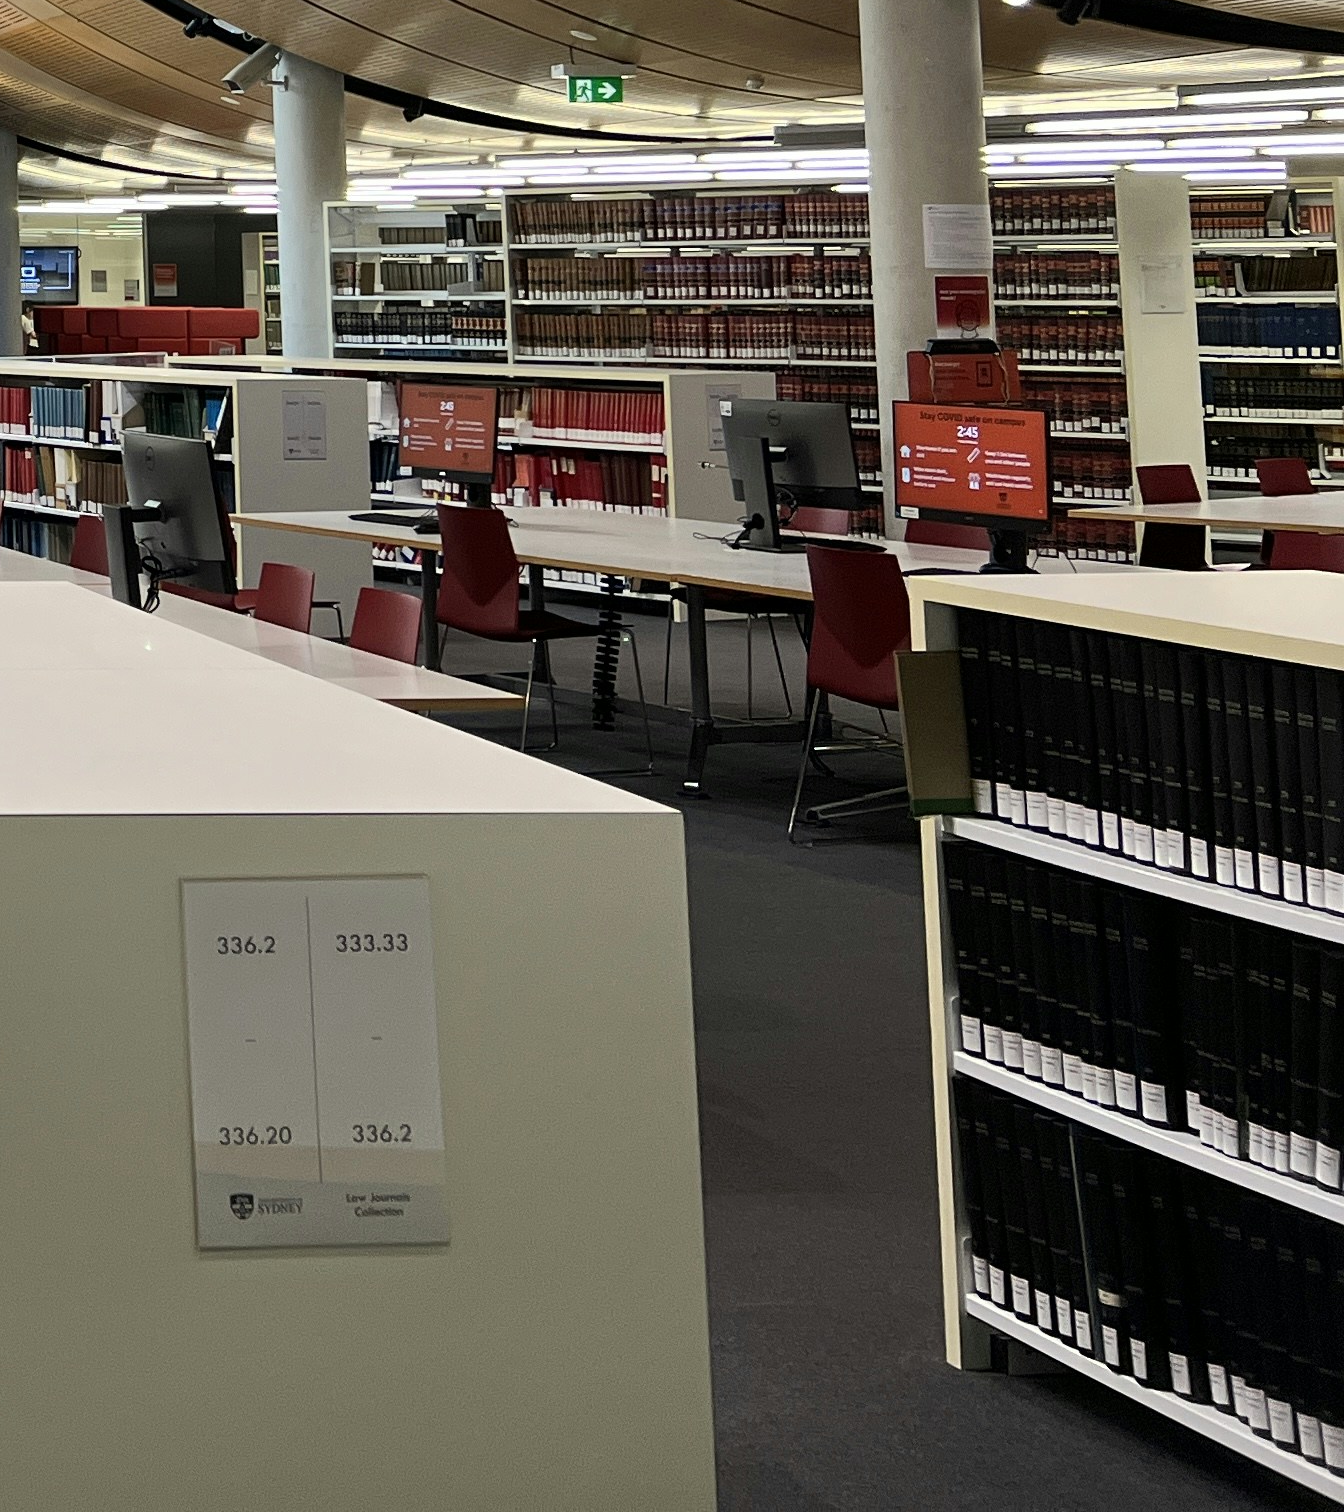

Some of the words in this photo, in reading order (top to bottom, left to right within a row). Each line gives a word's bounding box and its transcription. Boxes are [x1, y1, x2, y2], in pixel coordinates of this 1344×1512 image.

[936, 412, 963, 422] COVID
[956, 425, 979, 438] 2:45
[217, 935, 276, 955] 336.2
[336, 933, 408, 953] 333.33
[219, 1125, 292, 1146] 336.20
[352, 1124, 412, 1144] 336.2
[346, 1193, 367, 1203] Law
[370, 1192, 411, 1204] Journals
[258, 1202, 302, 1215] SYDNEY
[354, 1206, 404, 1218] Collection
